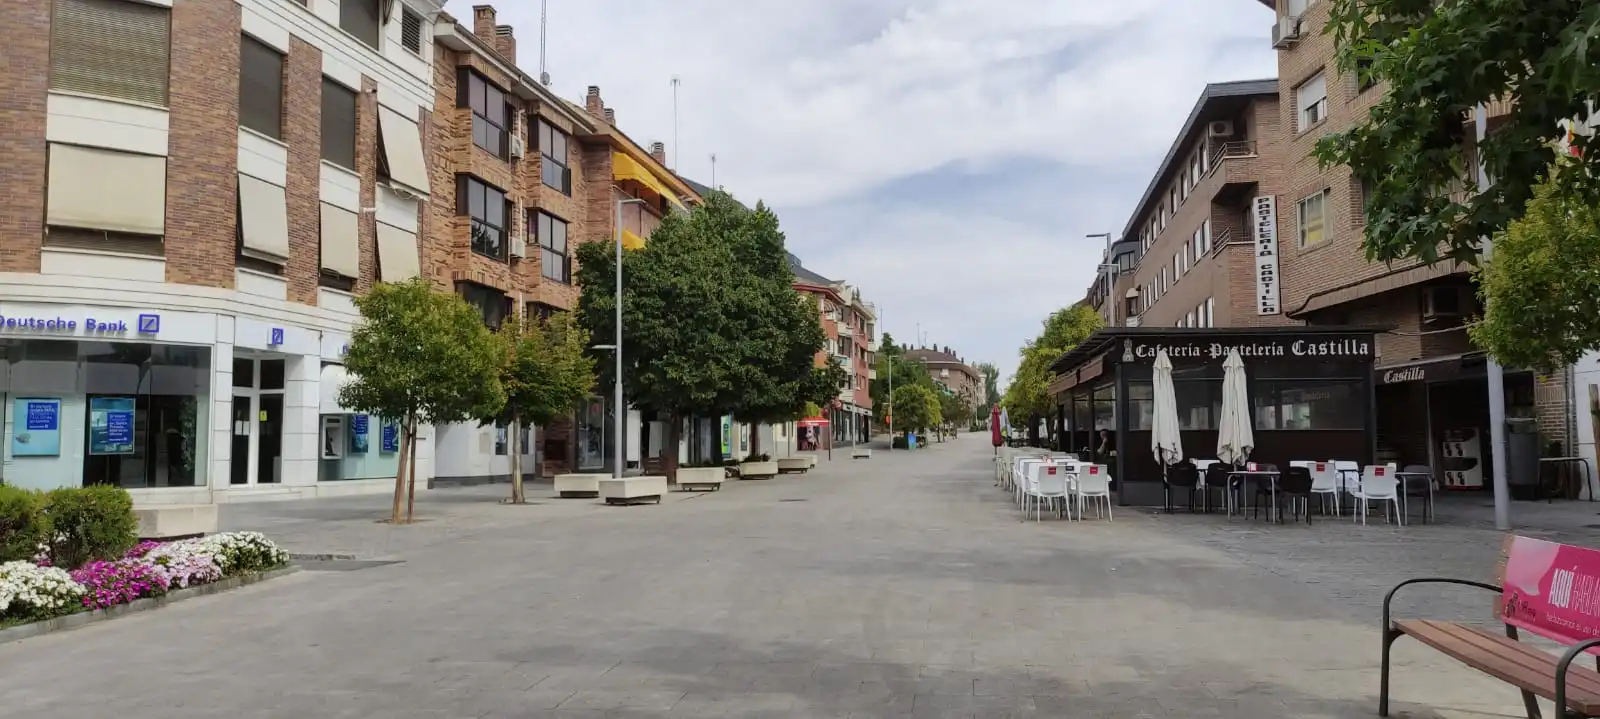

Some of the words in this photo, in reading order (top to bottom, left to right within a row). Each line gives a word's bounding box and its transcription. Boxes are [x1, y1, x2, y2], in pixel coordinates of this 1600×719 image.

[1260, 264, 1275, 312] CASTILLA
[86, 318, 128, 332] Bank
[1291, 339, 1369, 356] Castilla
[1383, 367, 1425, 384] Castilla
